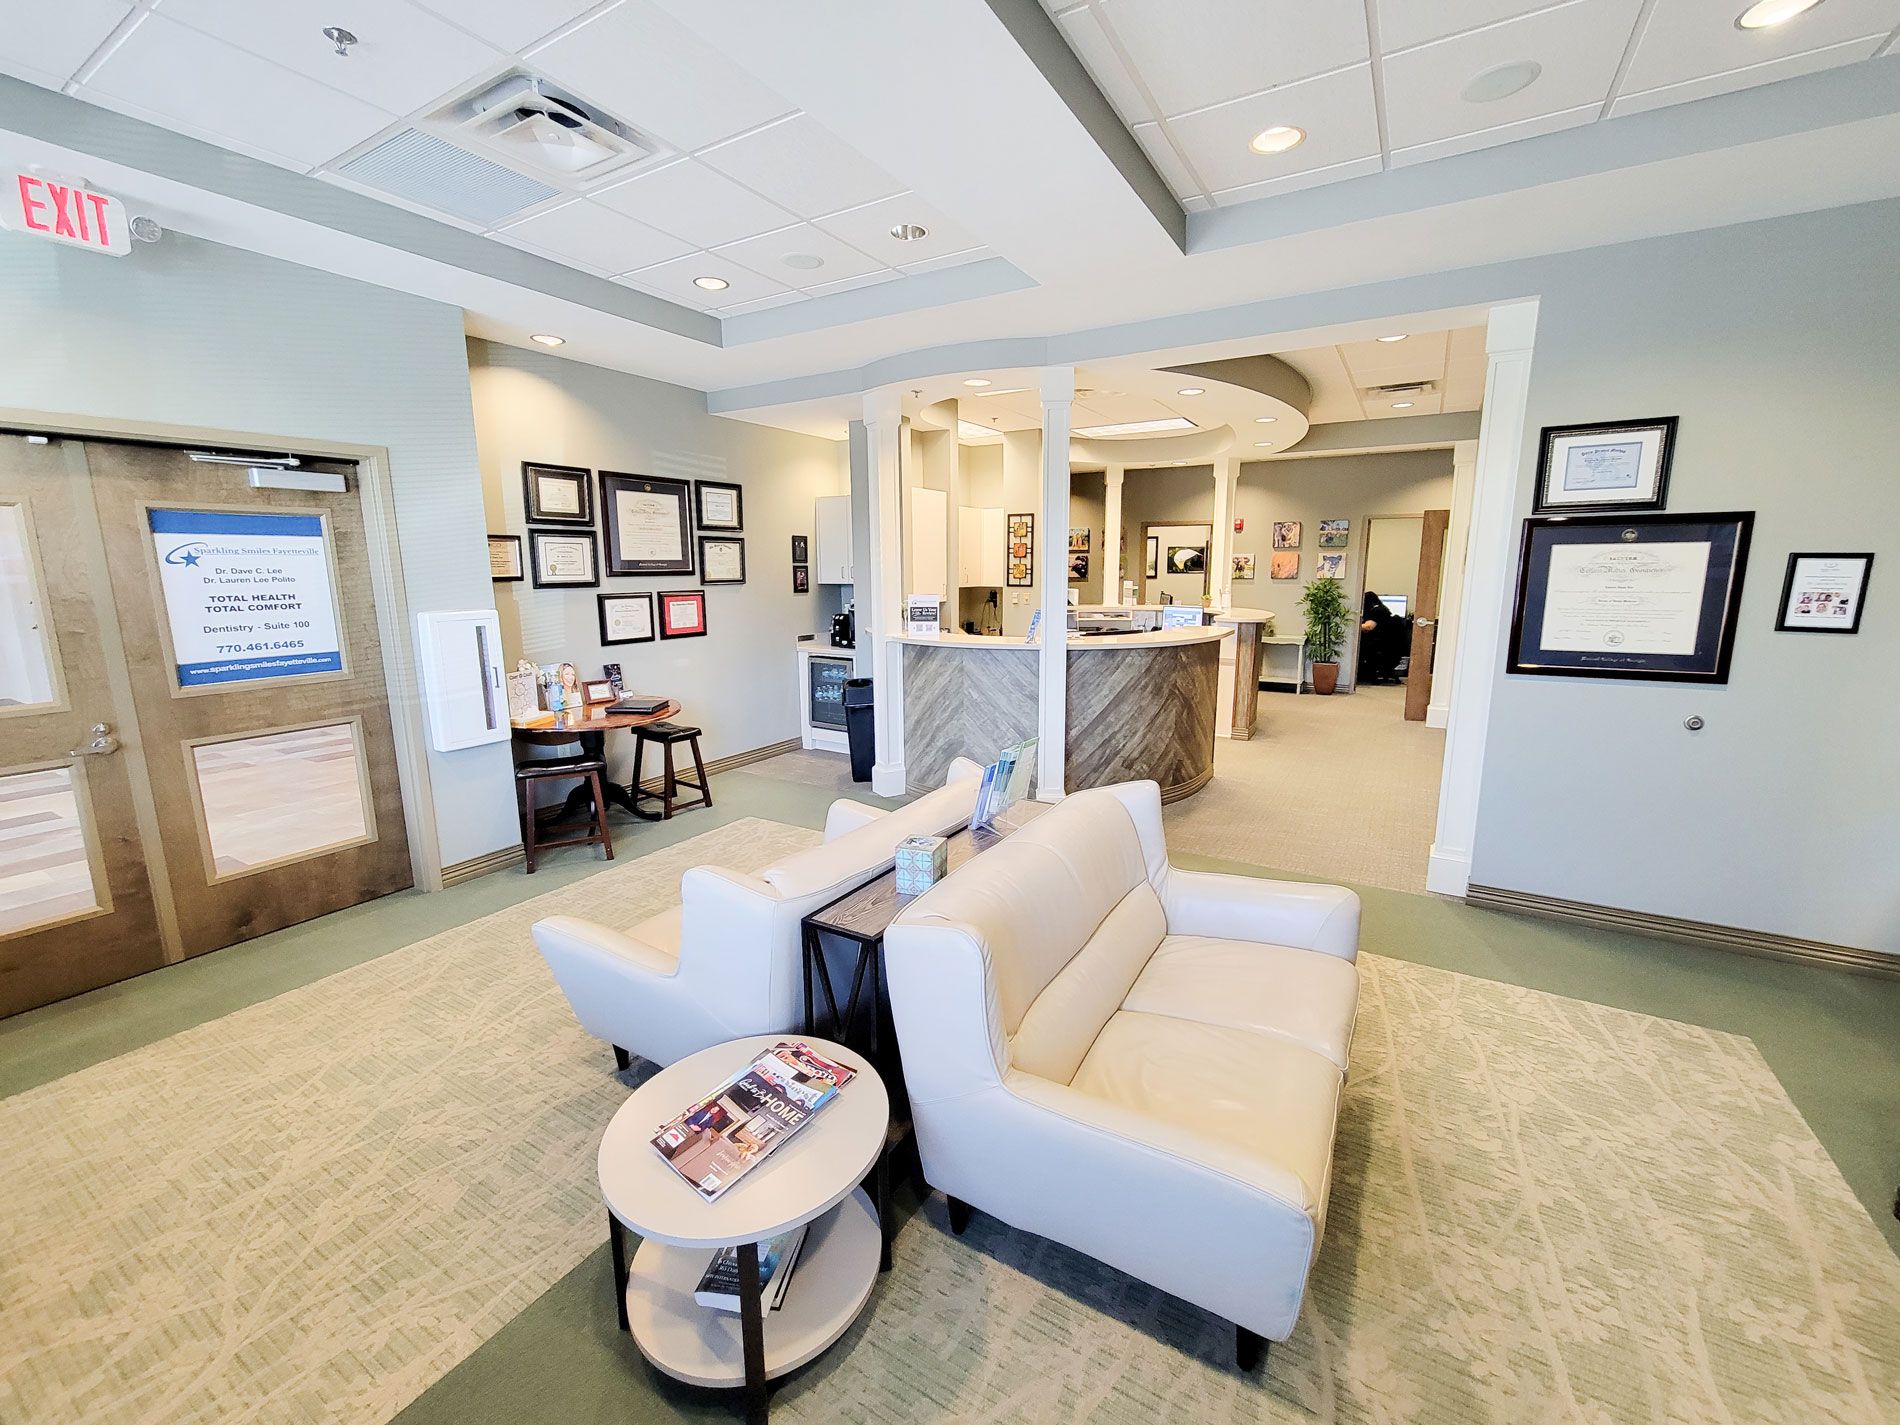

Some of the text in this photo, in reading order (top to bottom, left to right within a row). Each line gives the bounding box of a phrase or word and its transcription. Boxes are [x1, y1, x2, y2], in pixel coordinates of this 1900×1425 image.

[18, 175, 110, 246] EXIT
[193, 546, 320, 556] Sparkling Smiles Fayetteville
[215, 567, 229, 575] Dr.
[230, 567, 253, 575] Dave
[219, 576, 251, 584] Lauren
[208, 593, 296, 603] TOTAL HEALTH
[205, 603, 303, 613] TOTAL COMFORT
[203, 624, 254, 634] Dentistry
[264, 622, 290, 631] Suite
[293, 620, 310, 629] 100
[216, 640, 305, 654] 770.461.6465
[189, 657, 332, 675] www.sparklingsmilesfayetteville.com
[765, 1093, 805, 1126] HOME
